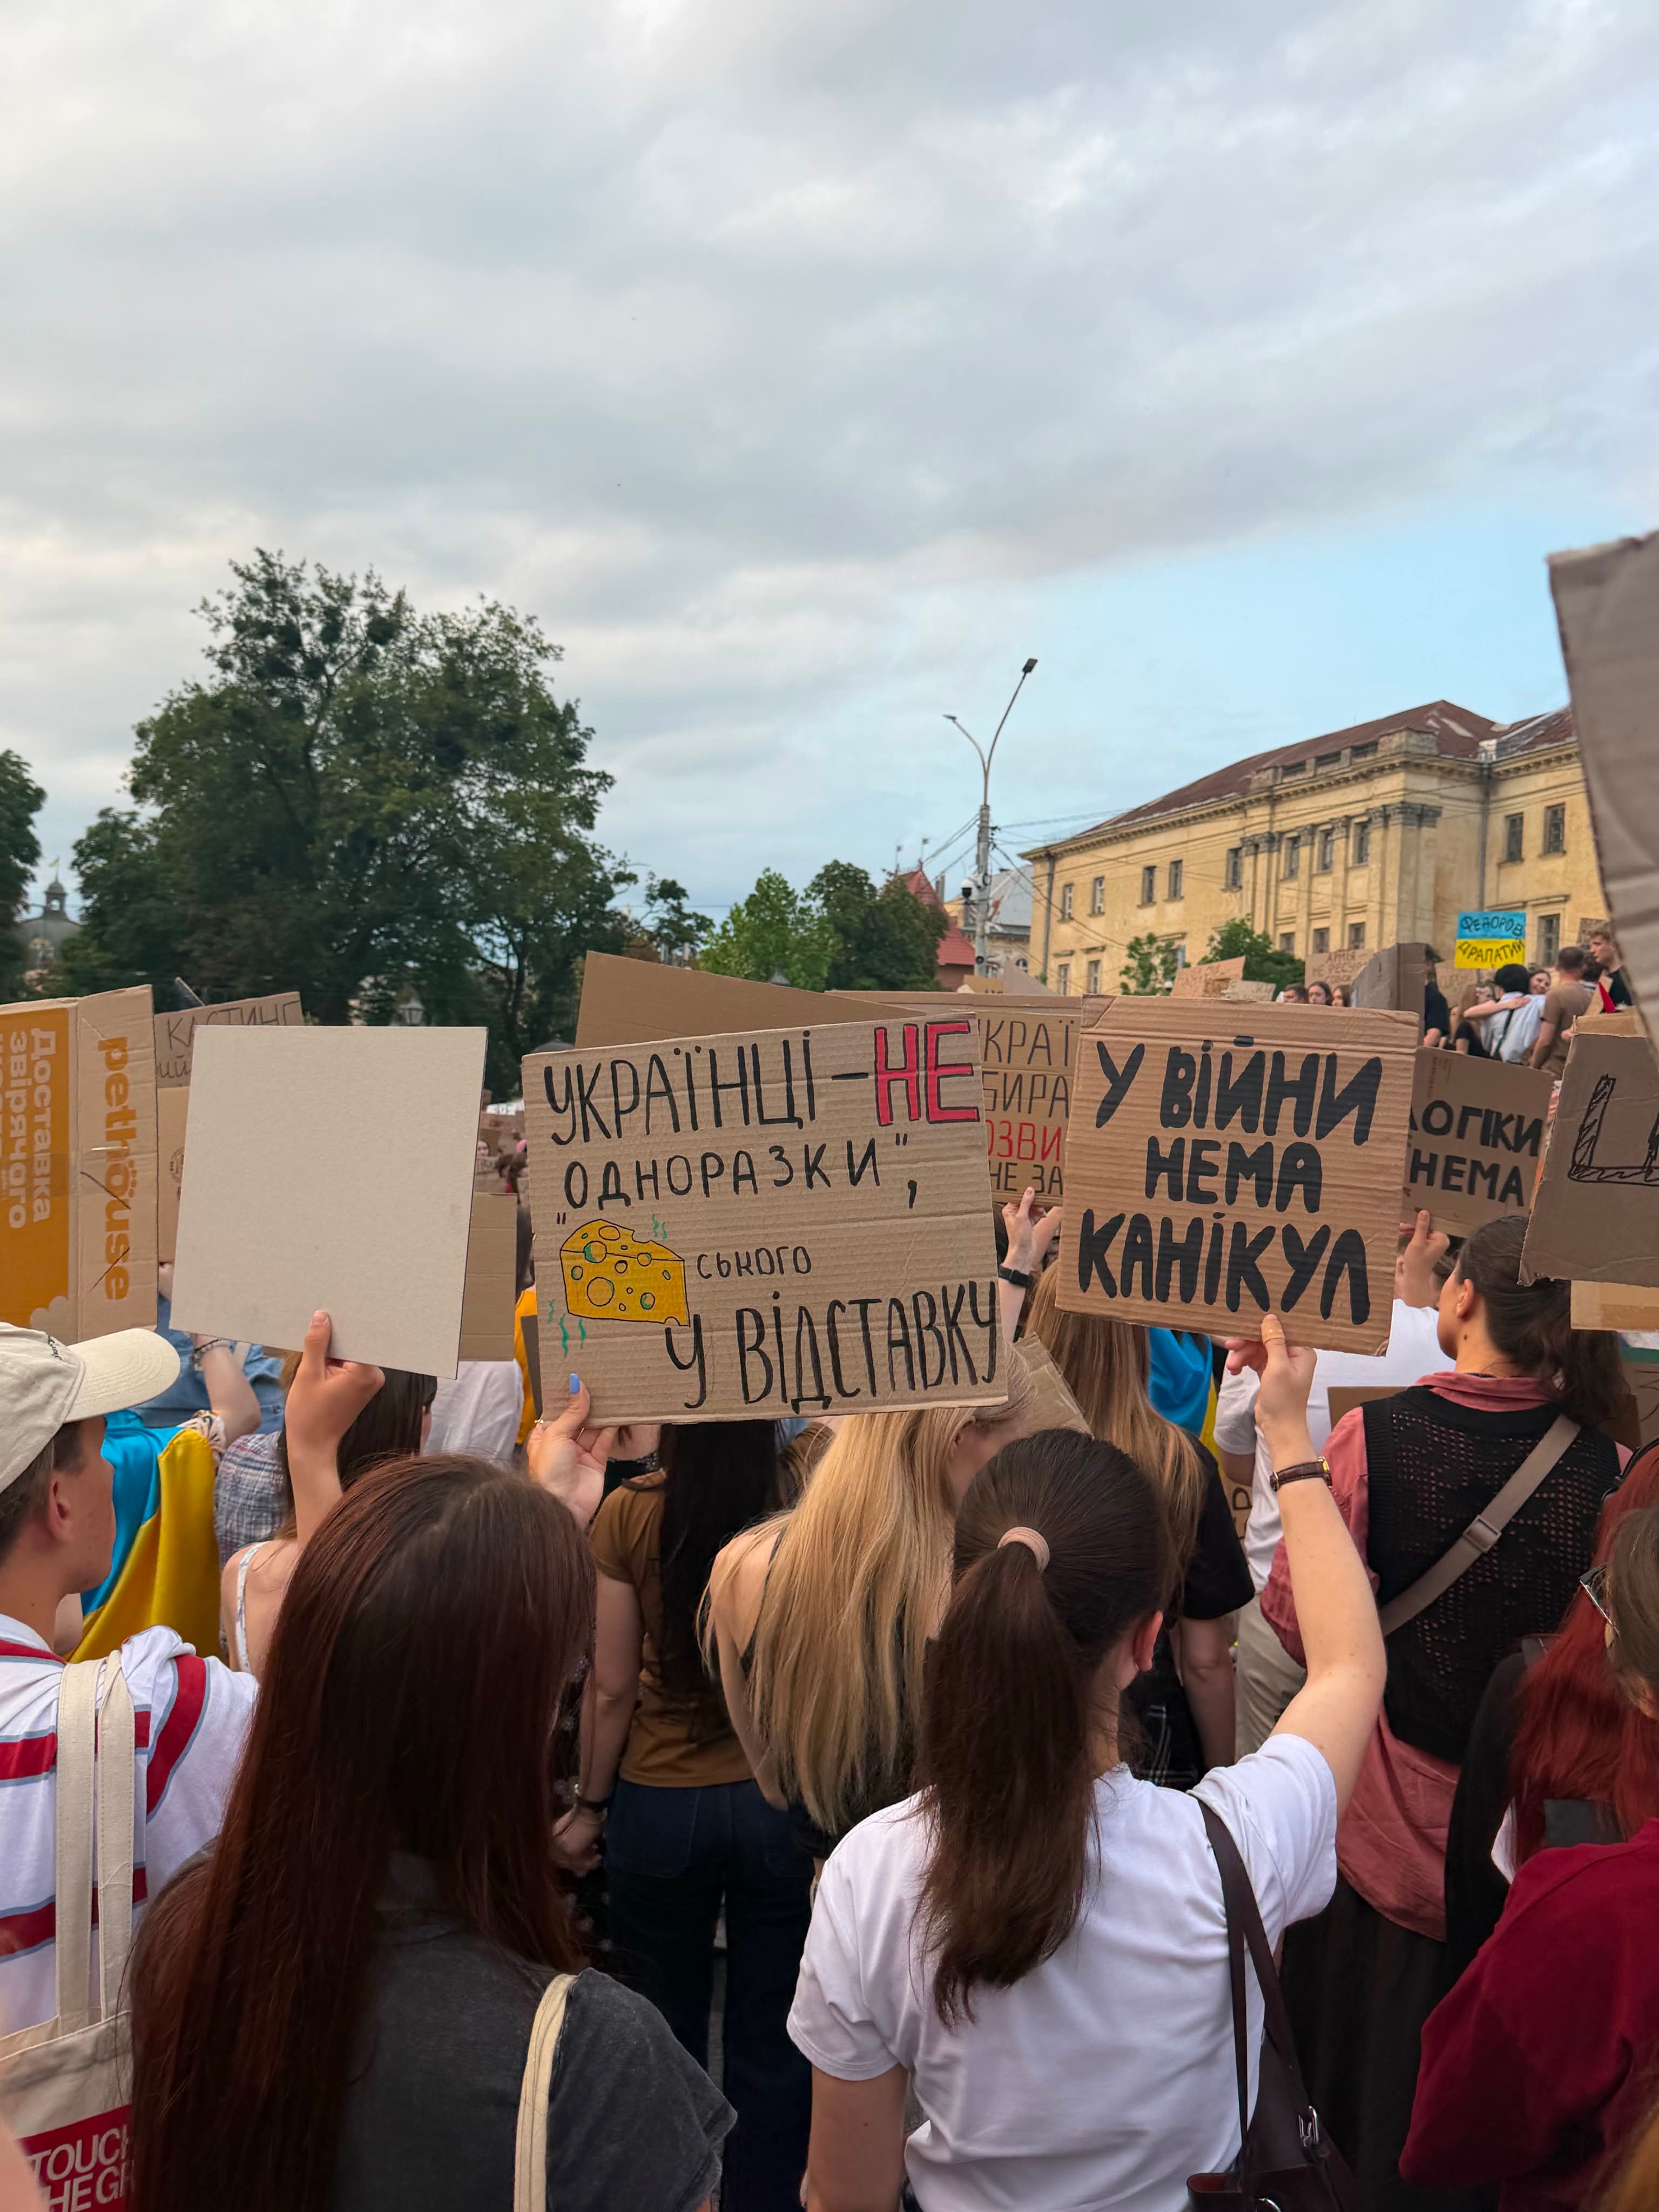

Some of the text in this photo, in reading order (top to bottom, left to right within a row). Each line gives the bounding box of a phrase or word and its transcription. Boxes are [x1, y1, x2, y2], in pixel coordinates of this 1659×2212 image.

[1458, 938, 1525, 962] ДРАПАТИЙ
[1460, 915, 1523, 936] ФЕДОРОВ
[874, 1020, 980, 1127] НЕ
[978, 1019, 1074, 1067] КРАЇ
[1095, 1041, 1145, 1129] У
[1159, 1035, 1383, 1146] ВІЙНИ
[5, 1030, 32, 1229] звірячого
[31, 1028, 56, 1222] Доставка
[98, 1036, 136, 1300] pethouse
[1145, 1136, 1323, 1213] НЕМА
[1409, 1148, 1524, 1207] НЕМА
[1078, 1208, 1371, 1326] КАНІКУЛ
[664, 1280, 997, 1415] У ВІДСТАВКУ
[40, 2173, 93, 2212] HE
